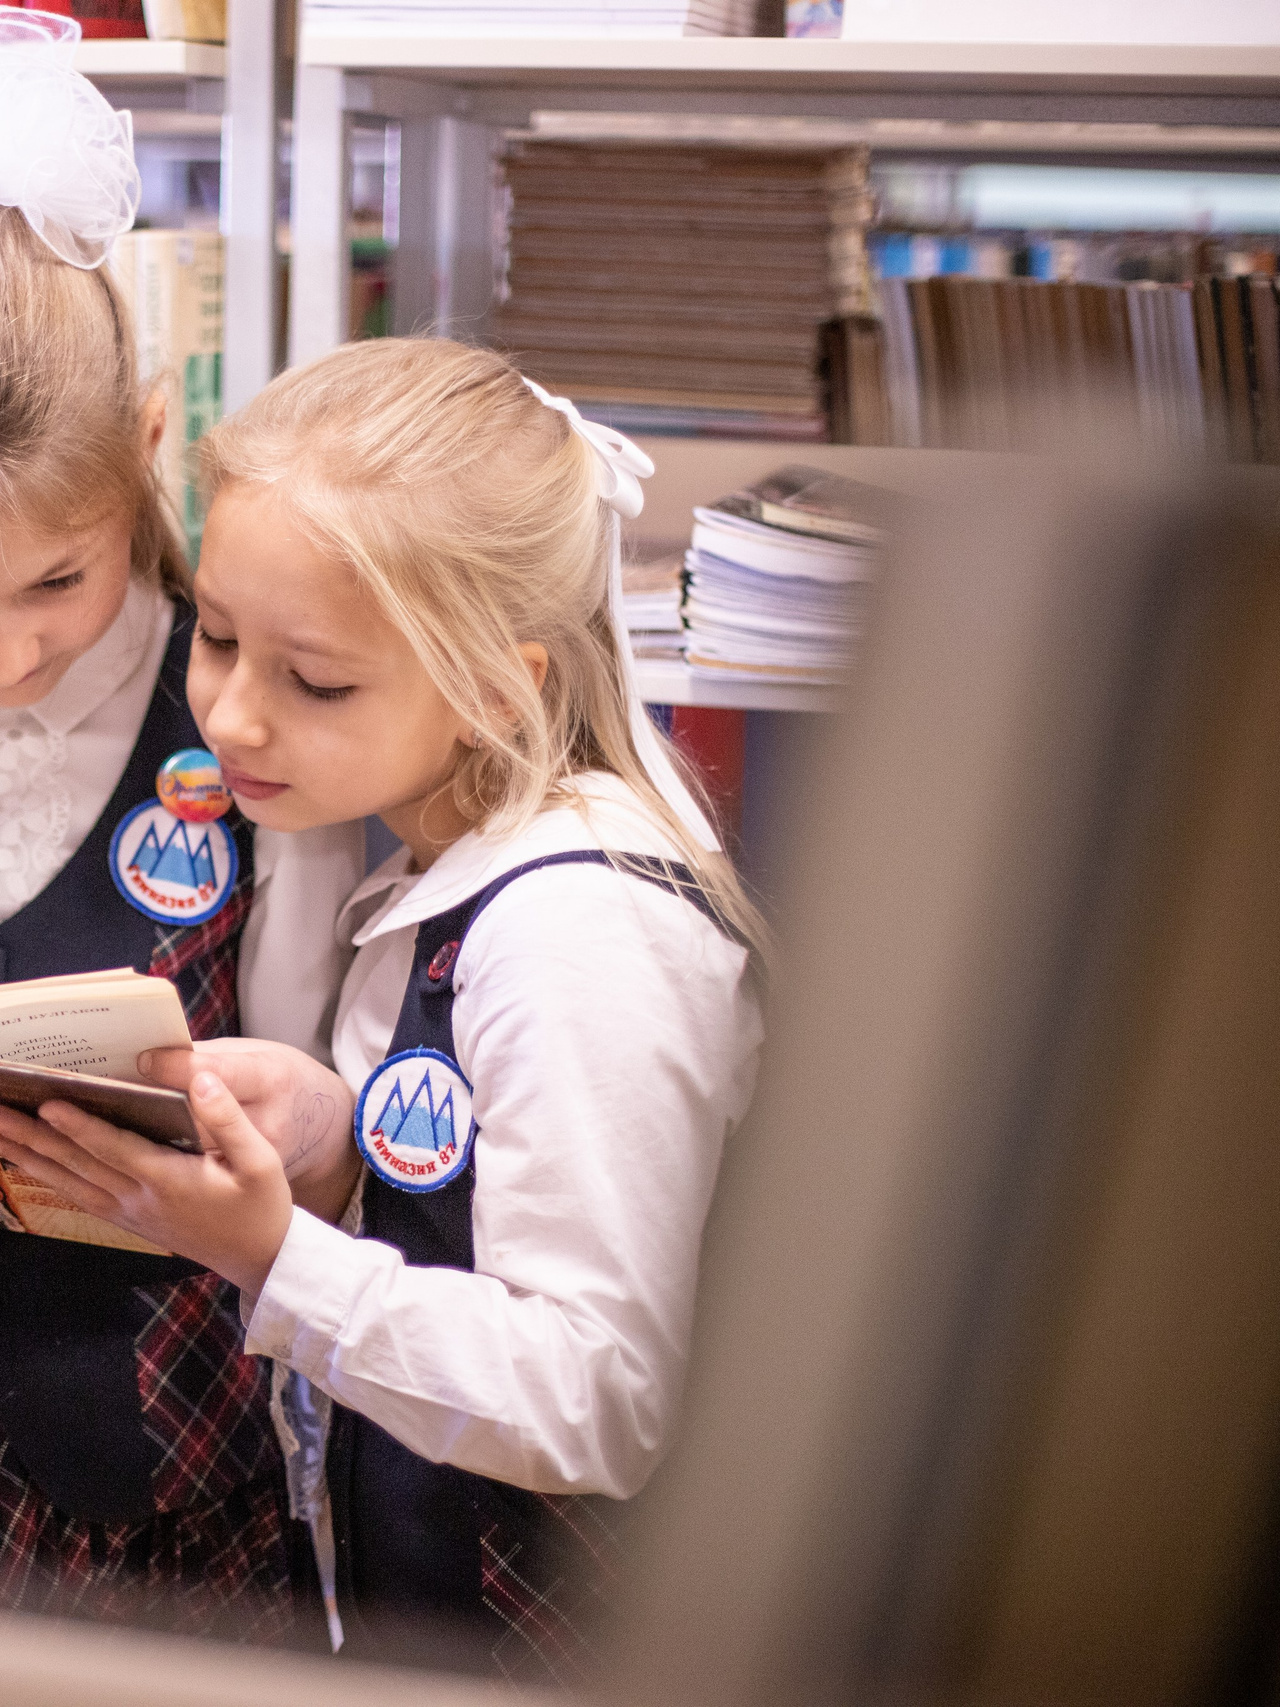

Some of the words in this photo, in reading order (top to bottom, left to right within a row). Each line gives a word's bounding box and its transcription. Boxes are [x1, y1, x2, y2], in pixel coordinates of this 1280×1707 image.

[28, 1007, 109, 1020] БУЛГАКОВ
[14, 1034, 68, 1047] ЖИЗНЬ
[0, 1038, 88, 1059] ГОСПОДИНА
[25, 1046, 93, 1061] МОЛЬЕРА
[439, 1141, 456, 1165] 87
